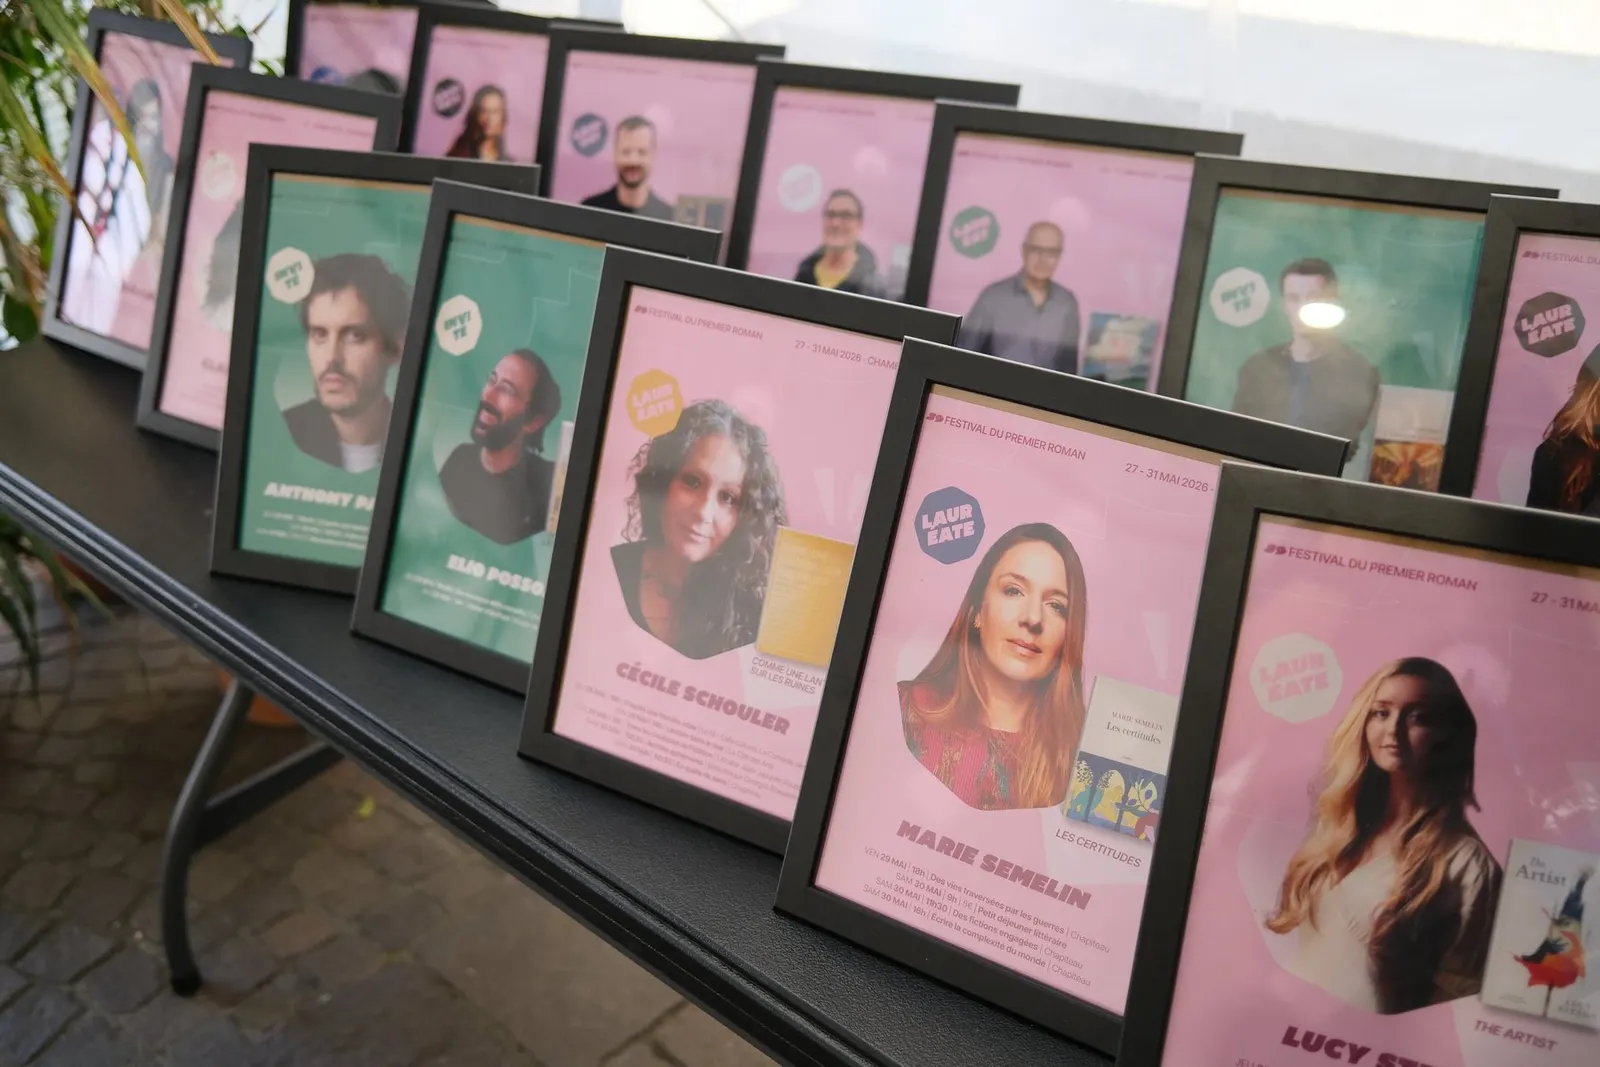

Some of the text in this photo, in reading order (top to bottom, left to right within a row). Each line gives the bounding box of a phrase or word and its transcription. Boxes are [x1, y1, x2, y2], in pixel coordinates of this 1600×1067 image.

[1541, 252, 1586, 263] FESTIVAL
[648, 307, 683, 322] FESTIVAL
[685, 316, 696, 326] DU
[698, 318, 731, 332] PREMIER
[732, 327, 762, 340] ROMAN
[1521, 304, 1573, 331] LAUR
[795, 340, 805, 348] 27
[812, 344, 822, 352] 31
[822, 346, 839, 356] MAI
[840, 350, 862, 362] 2026
[944, 416, 988, 435] FESTIVAL
[990, 427, 1004, 438] DU
[1005, 432, 1046, 450] PREMIER
[1047, 442, 1086, 460] ROMAN
[1125, 463, 1138, 474] 27
[1146, 468, 1158, 480] 31
[1160, 472, 1180, 484] MAI
[1181, 478, 1208, 492] 2026
[922, 504, 972, 530] LAUR
[447, 554, 486, 578] ELIO
[1288, 546, 1345, 568] FESTIVAL
[1349, 558, 1367, 571] DU
[1369, 562, 1424, 582] PREMIER
[1426, 572, 1478, 591] ROMAN
[1531, 592, 1548, 604] 27
[1559, 596, 1575, 610] 31
[750, 666, 816, 694] SUR LES RUINES
[752, 656, 826, 686] COMME UNE LAN
[1258, 652, 1325, 684] LAUR
[616, 662, 790, 735] CÉCILE SCHOULER
[1106, 721, 1162, 744] Les certitudes
[1056, 829, 1142, 868] LES CERTITUDES
[896, 820, 1092, 910] MARIE SEMELIN
[1515, 864, 1567, 887] Artist
[864, 846, 878, 858] VEN
[880, 853, 890, 862] 29
[891, 857, 906, 870] MAI
[912, 866, 926, 878] 18h
[931, 874, 945, 886] Des
[946, 880, 962, 892] vies
[963, 886, 1004, 910] traversées
[1005, 905, 1018, 916] par
[1020, 910, 1032, 921] les
[1033, 916, 1064, 934] guerres
[1070, 930, 1110, 954] Chapiteau
[896, 872, 913, 884] SAM
[914, 881, 926, 890] 30
[926, 884, 942, 897] MAI
[948, 893, 958, 904] 9h
[978, 906, 996, 920] Petit
[997, 915, 1033, 934] déjeuner
[1033, 928, 1068, 950] littéraire
[862, 884, 880, 896] SAM
[881, 892, 892, 902] 30
[892, 896, 908, 909] MAI
[913, 906, 926, 917] 16h
[954, 922, 962, 932] la
[962, 928, 1005, 951] complexité
[1006, 945, 1017, 956] du
[1018, 950, 1046, 968] monde
[1052, 964, 1092, 988] Chapiteau
[876, 876, 892, 890] SAM
[894, 884, 904, 894] 30
[905, 890, 920, 901] MAI
[926, 898, 948, 912] 11h30
[952, 909, 968, 922] Des
[969, 915, 998, 934] fictions
[999, 930, 1038, 951] engagées
[1044, 946, 1084, 970] Chapiteau
[1282, 1025, 1372, 1065] LUCY
[1474, 1020, 1558, 1051] THE ARTIST
